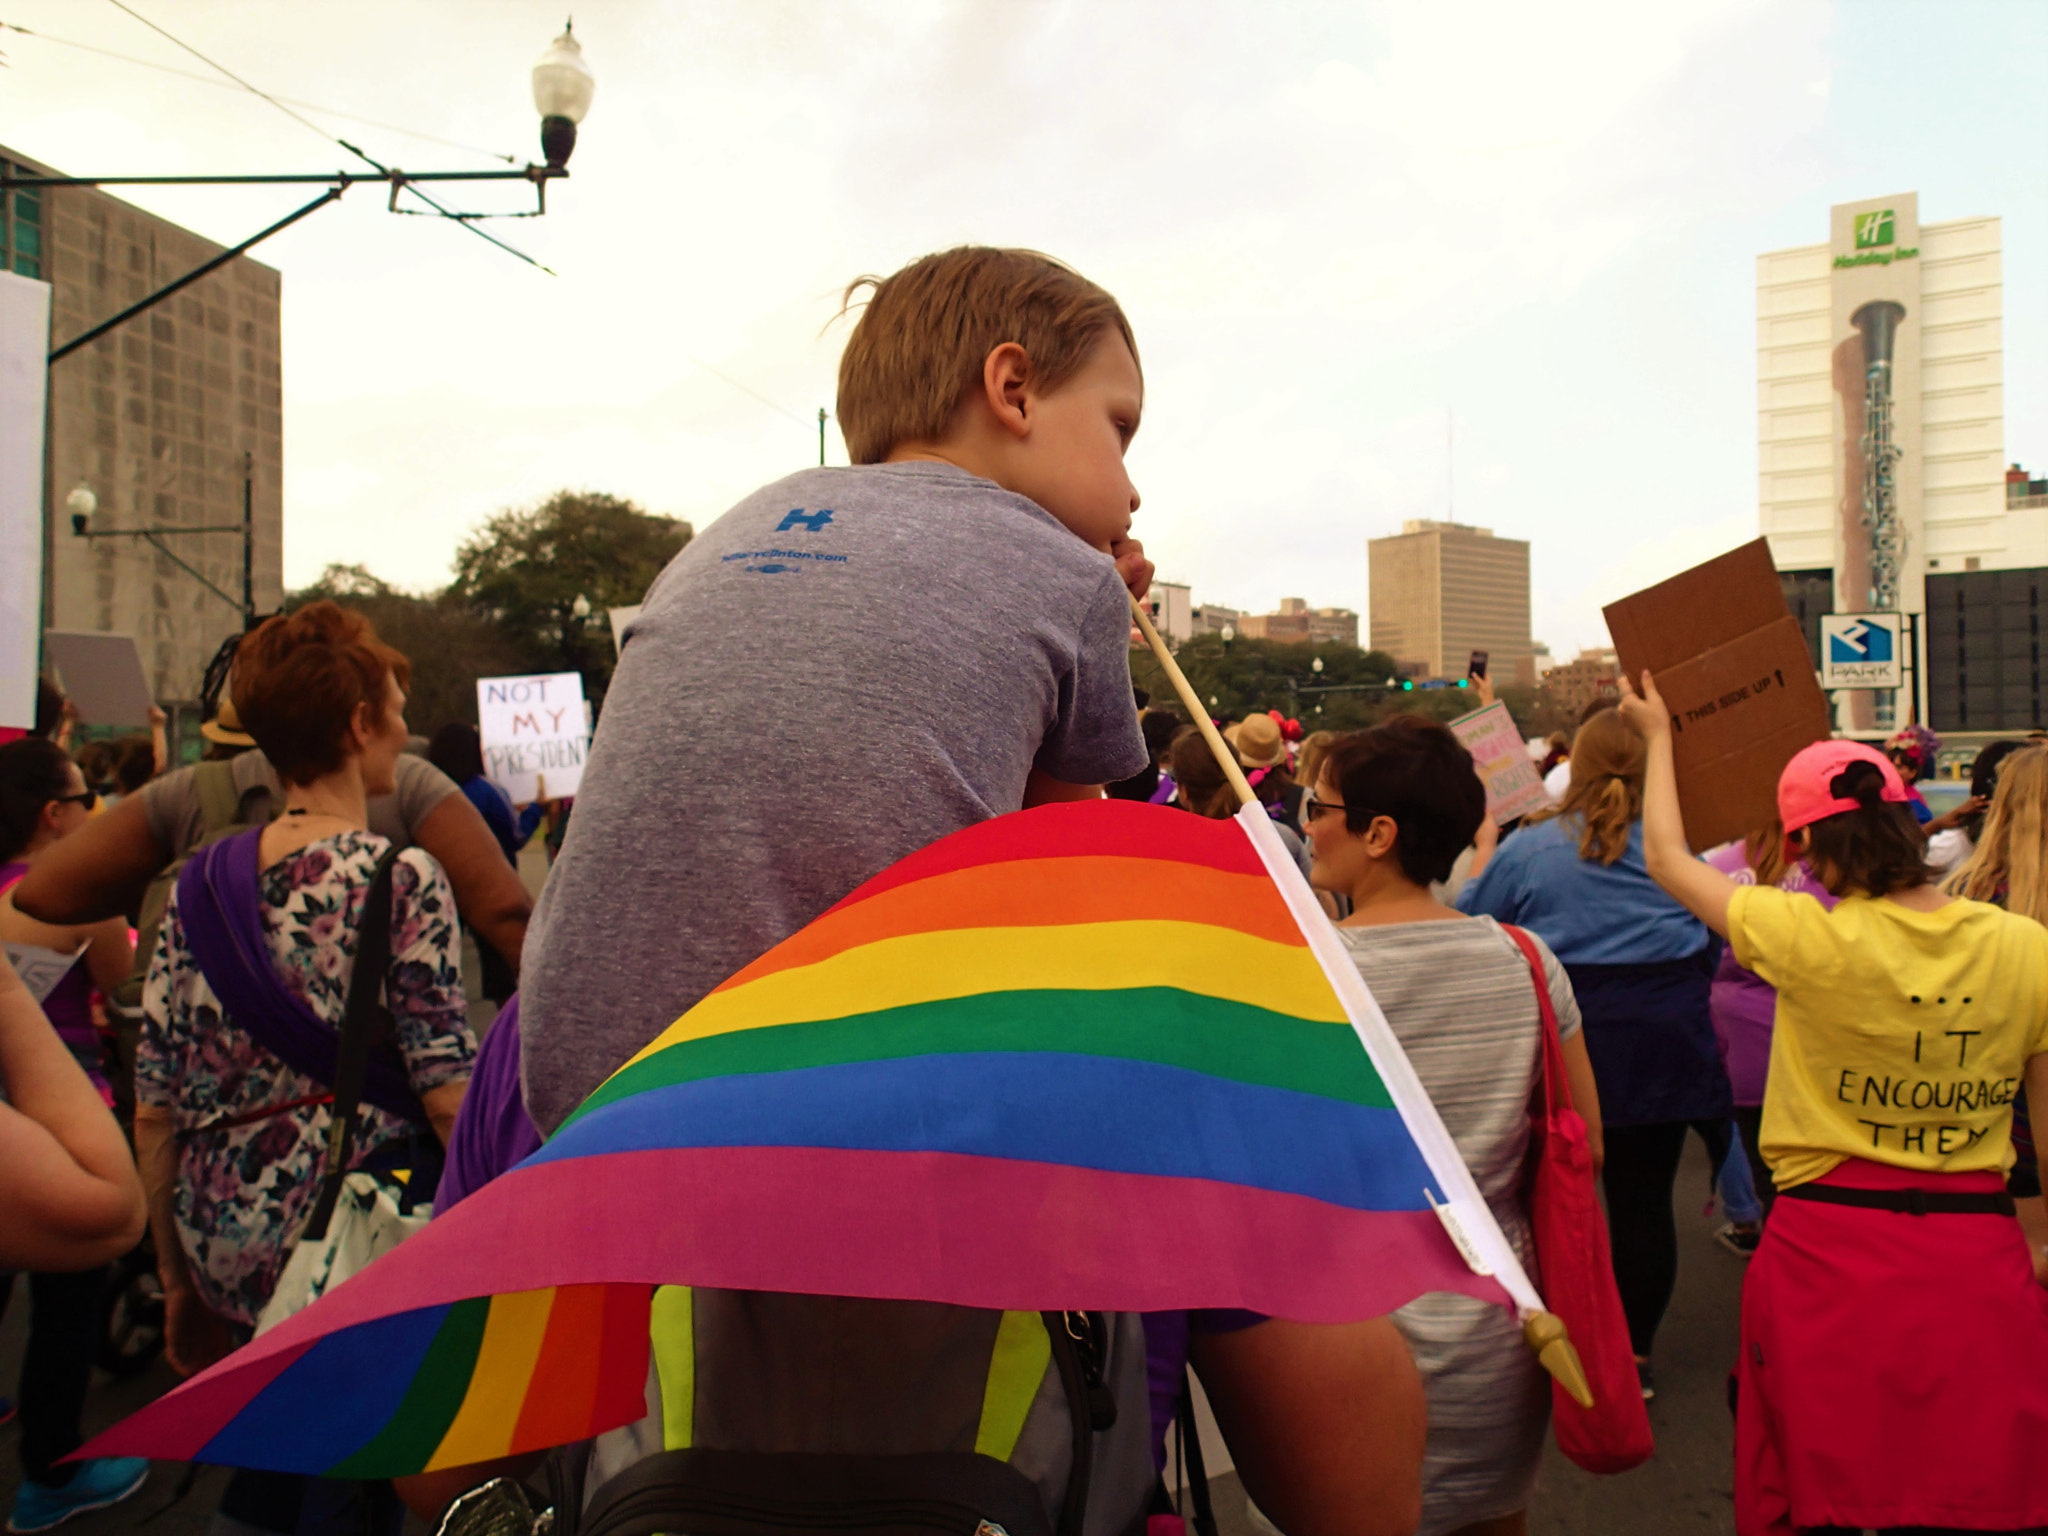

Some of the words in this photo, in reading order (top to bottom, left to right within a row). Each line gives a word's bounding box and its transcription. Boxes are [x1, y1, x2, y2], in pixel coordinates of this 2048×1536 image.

[722, 549, 847, 562] yclinton.com
[487, 679, 552, 703] NOT
[1686, 701, 1717, 722] THIS
[1719, 687, 1751, 709] SIDE
[1752, 677, 1771, 694] UP
[512, 706, 567, 735] MY
[484, 736, 588, 778] PRESIDENT
[1914, 1030, 1982, 1067] IT
[1838, 1070, 2017, 1113] ENCOURAGE
